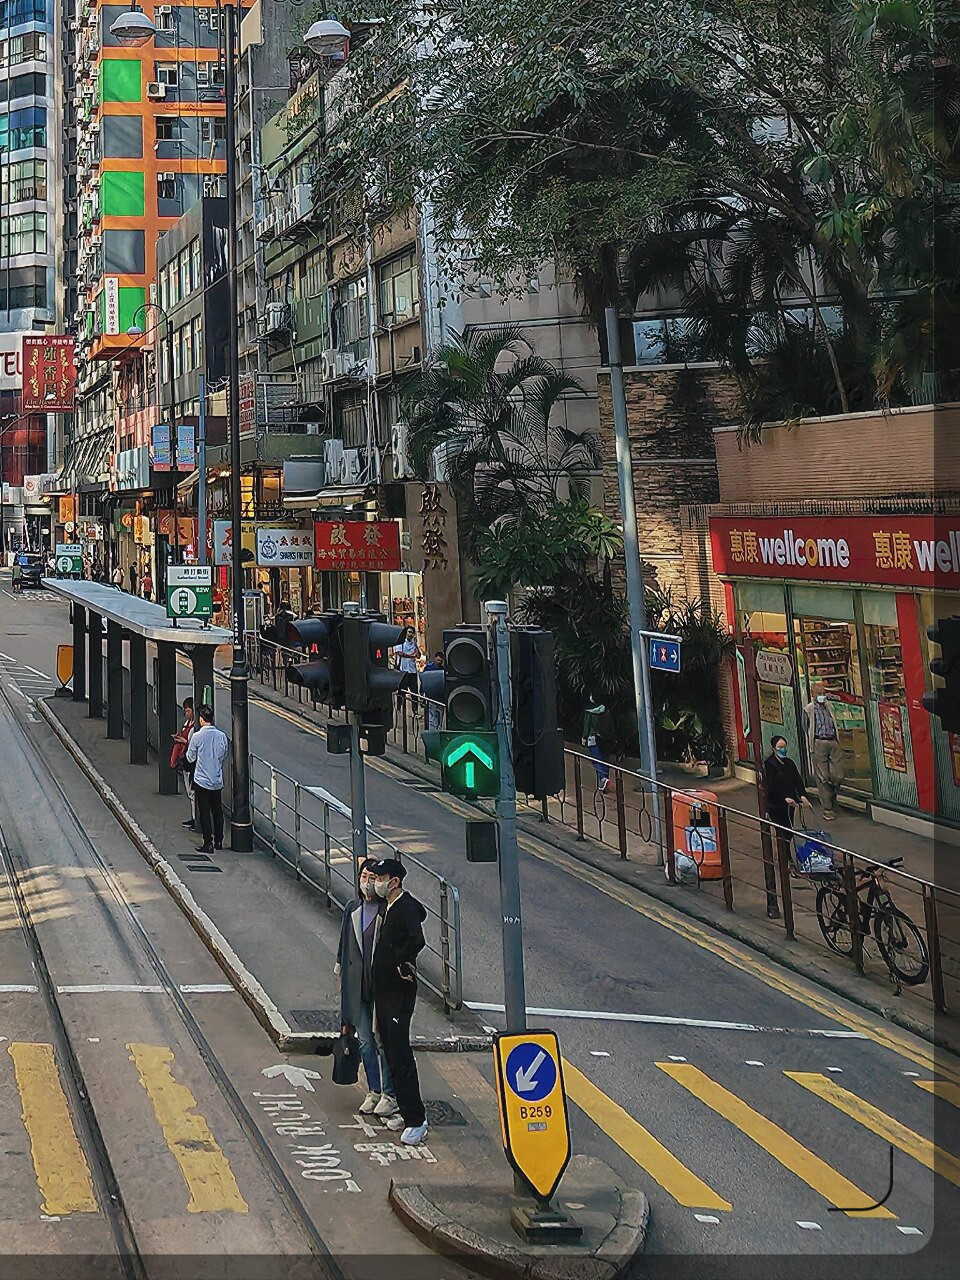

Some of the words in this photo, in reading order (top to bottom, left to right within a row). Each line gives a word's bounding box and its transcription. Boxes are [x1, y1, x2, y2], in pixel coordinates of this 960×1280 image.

[729, 528, 759, 564] 惠康
[759, 529, 850, 568] wellcome
[873, 530, 914, 571] 惠康
[520, 1105, 552, 1119] B259
